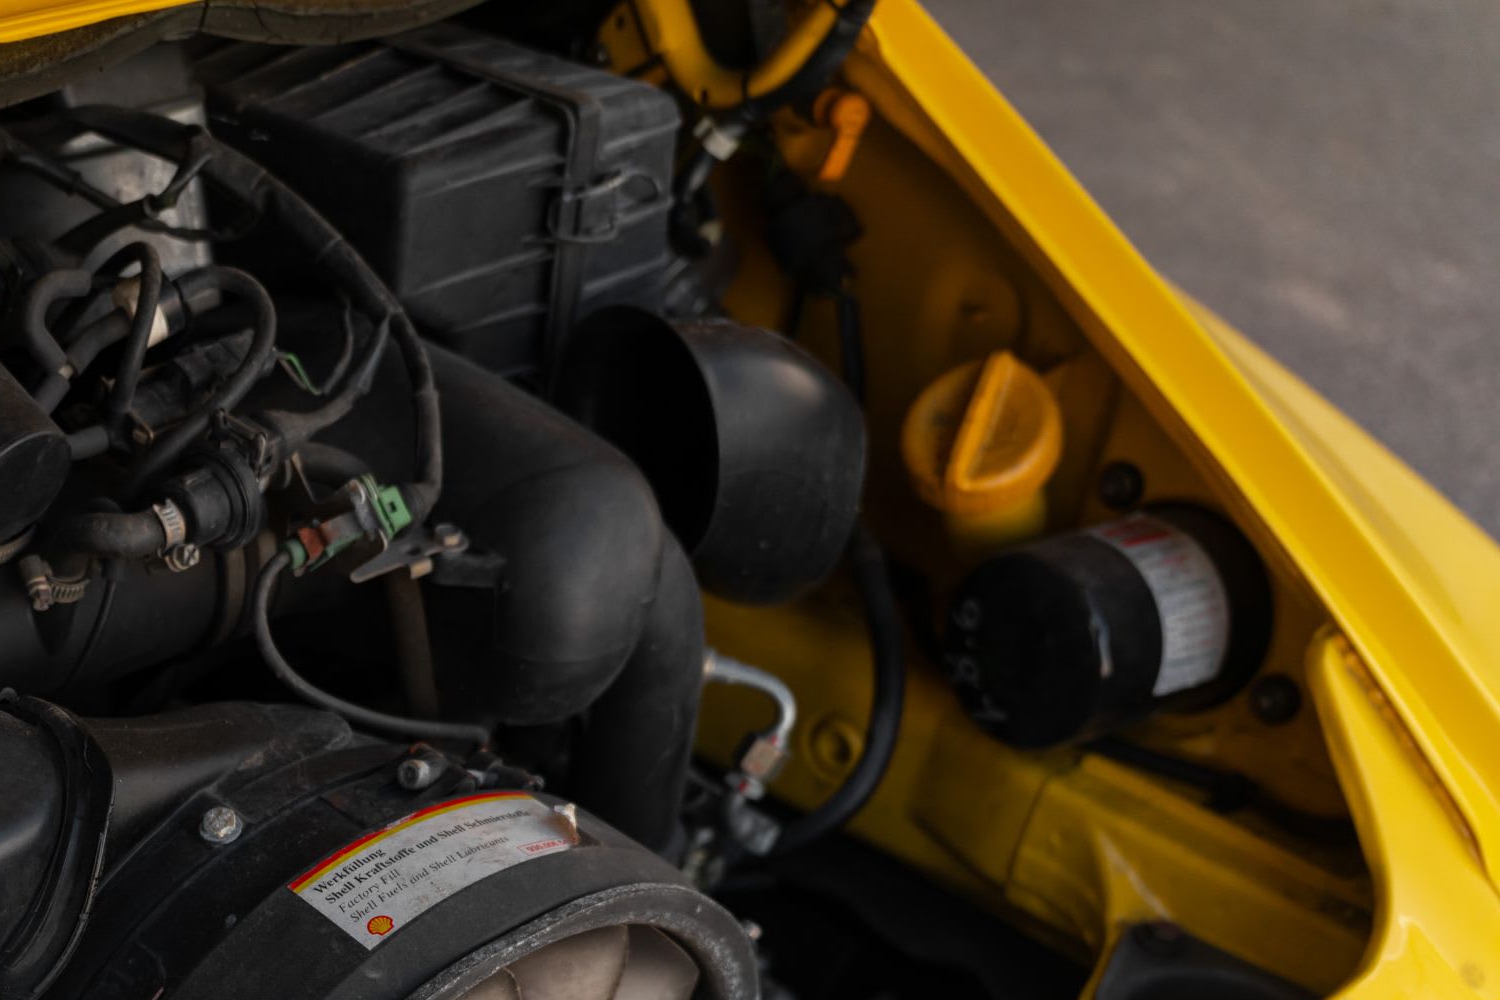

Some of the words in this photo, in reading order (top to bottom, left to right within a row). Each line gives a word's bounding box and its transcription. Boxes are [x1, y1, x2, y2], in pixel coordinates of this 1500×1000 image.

[313, 847, 386, 894] Werkfüllung
[325, 882, 354, 904] Shell
[356, 845, 415, 883] Kraftstoffe
[415, 835, 438, 850] und
[438, 825, 464, 840] Shell
[338, 881, 381, 913] Factory
[380, 868, 401, 886] Fill
[349, 899, 378, 923] Shell
[380, 880, 408, 903] Fuels
[409, 868, 428, 884] and
[429, 854, 456, 873] Shell
[457, 836, 508, 858] Lubricants
